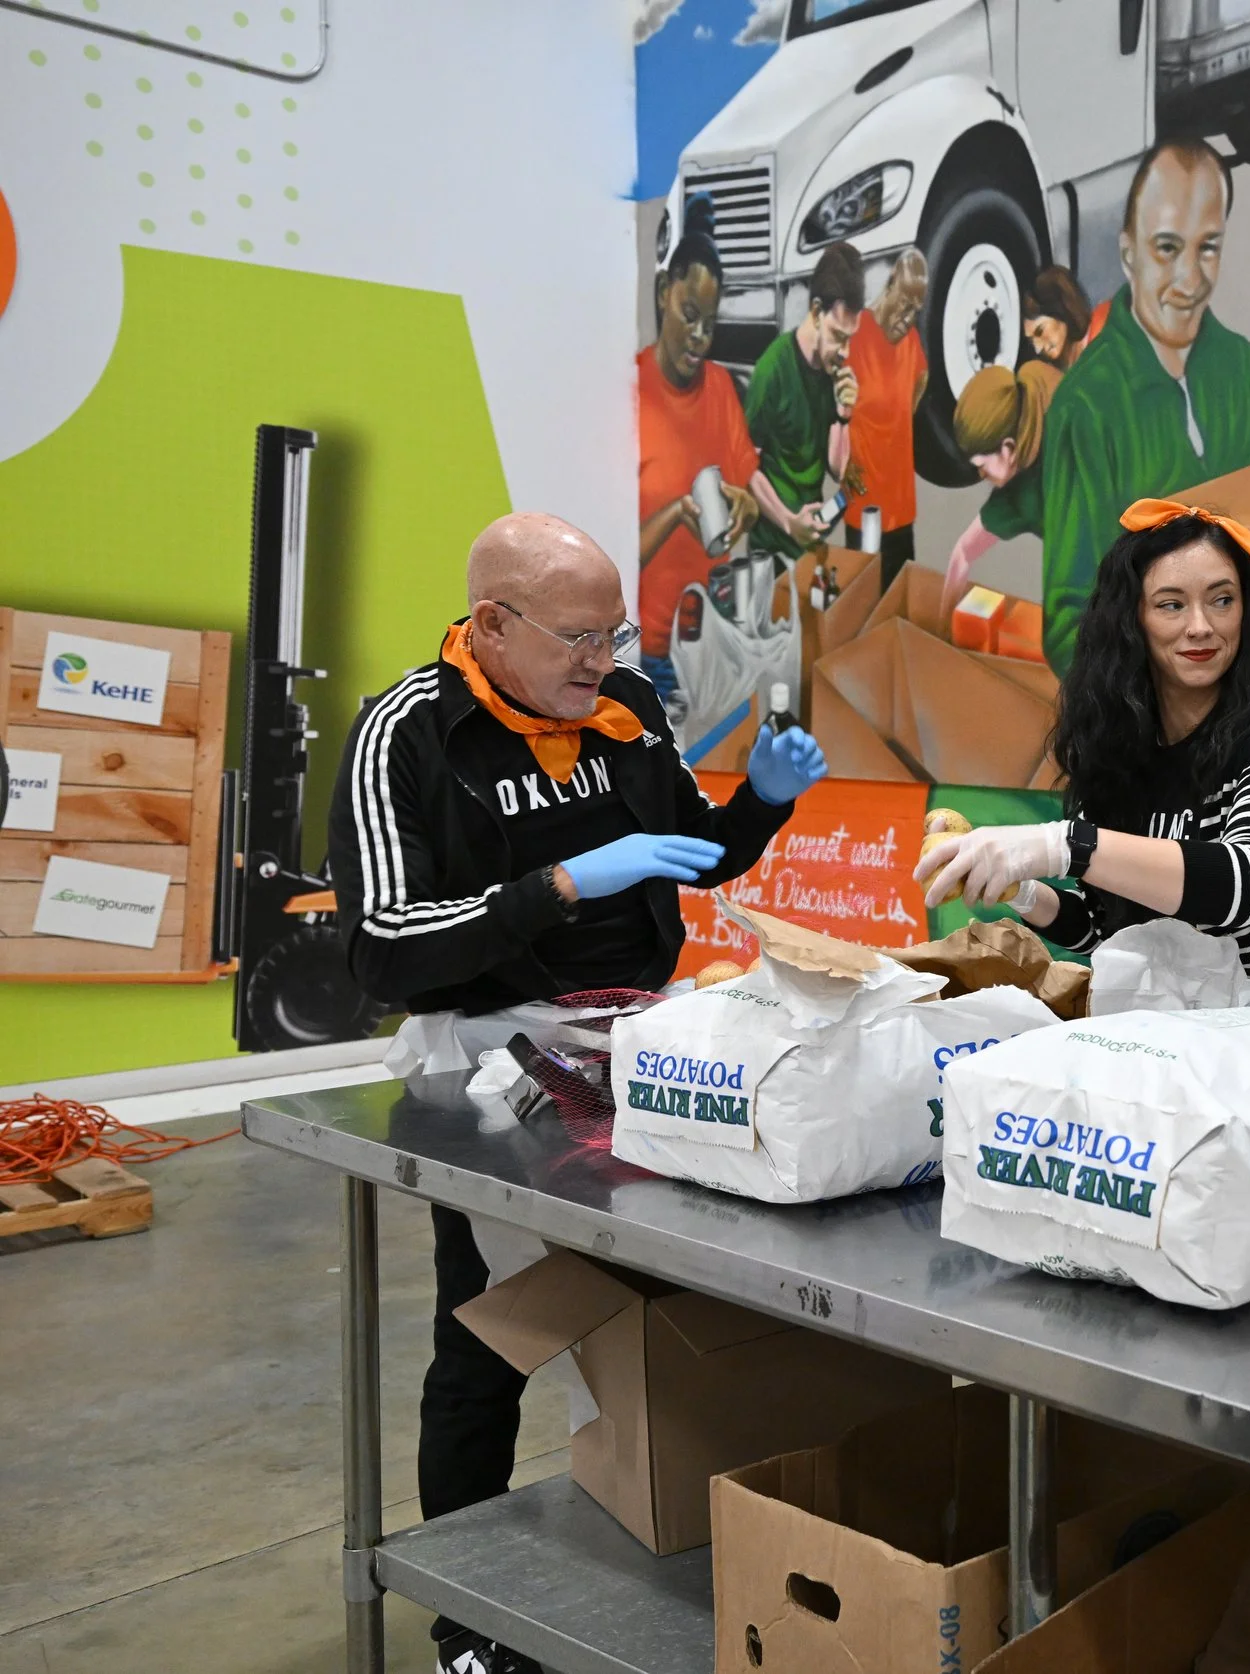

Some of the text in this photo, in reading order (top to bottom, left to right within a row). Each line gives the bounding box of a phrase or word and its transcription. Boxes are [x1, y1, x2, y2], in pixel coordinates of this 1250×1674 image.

[91, 680, 154, 703] KeHE
[9, 777, 48, 789] neral
[784, 825, 851, 863] cannot
[775, 867, 886, 922] Discussion
[886, 887, 918, 928] is
[1066, 1032, 1127, 1053] PRODUCE
[1125, 1042, 1146, 1052] OF
[635, 1050, 745, 1090] POTATOES
[627, 1080, 750, 1127] PINE RIVER
[993, 1111, 1157, 1172] POTATOES
[977, 1144, 1075, 1197] RIVER
[1074, 1165, 1160, 1218] PINE
